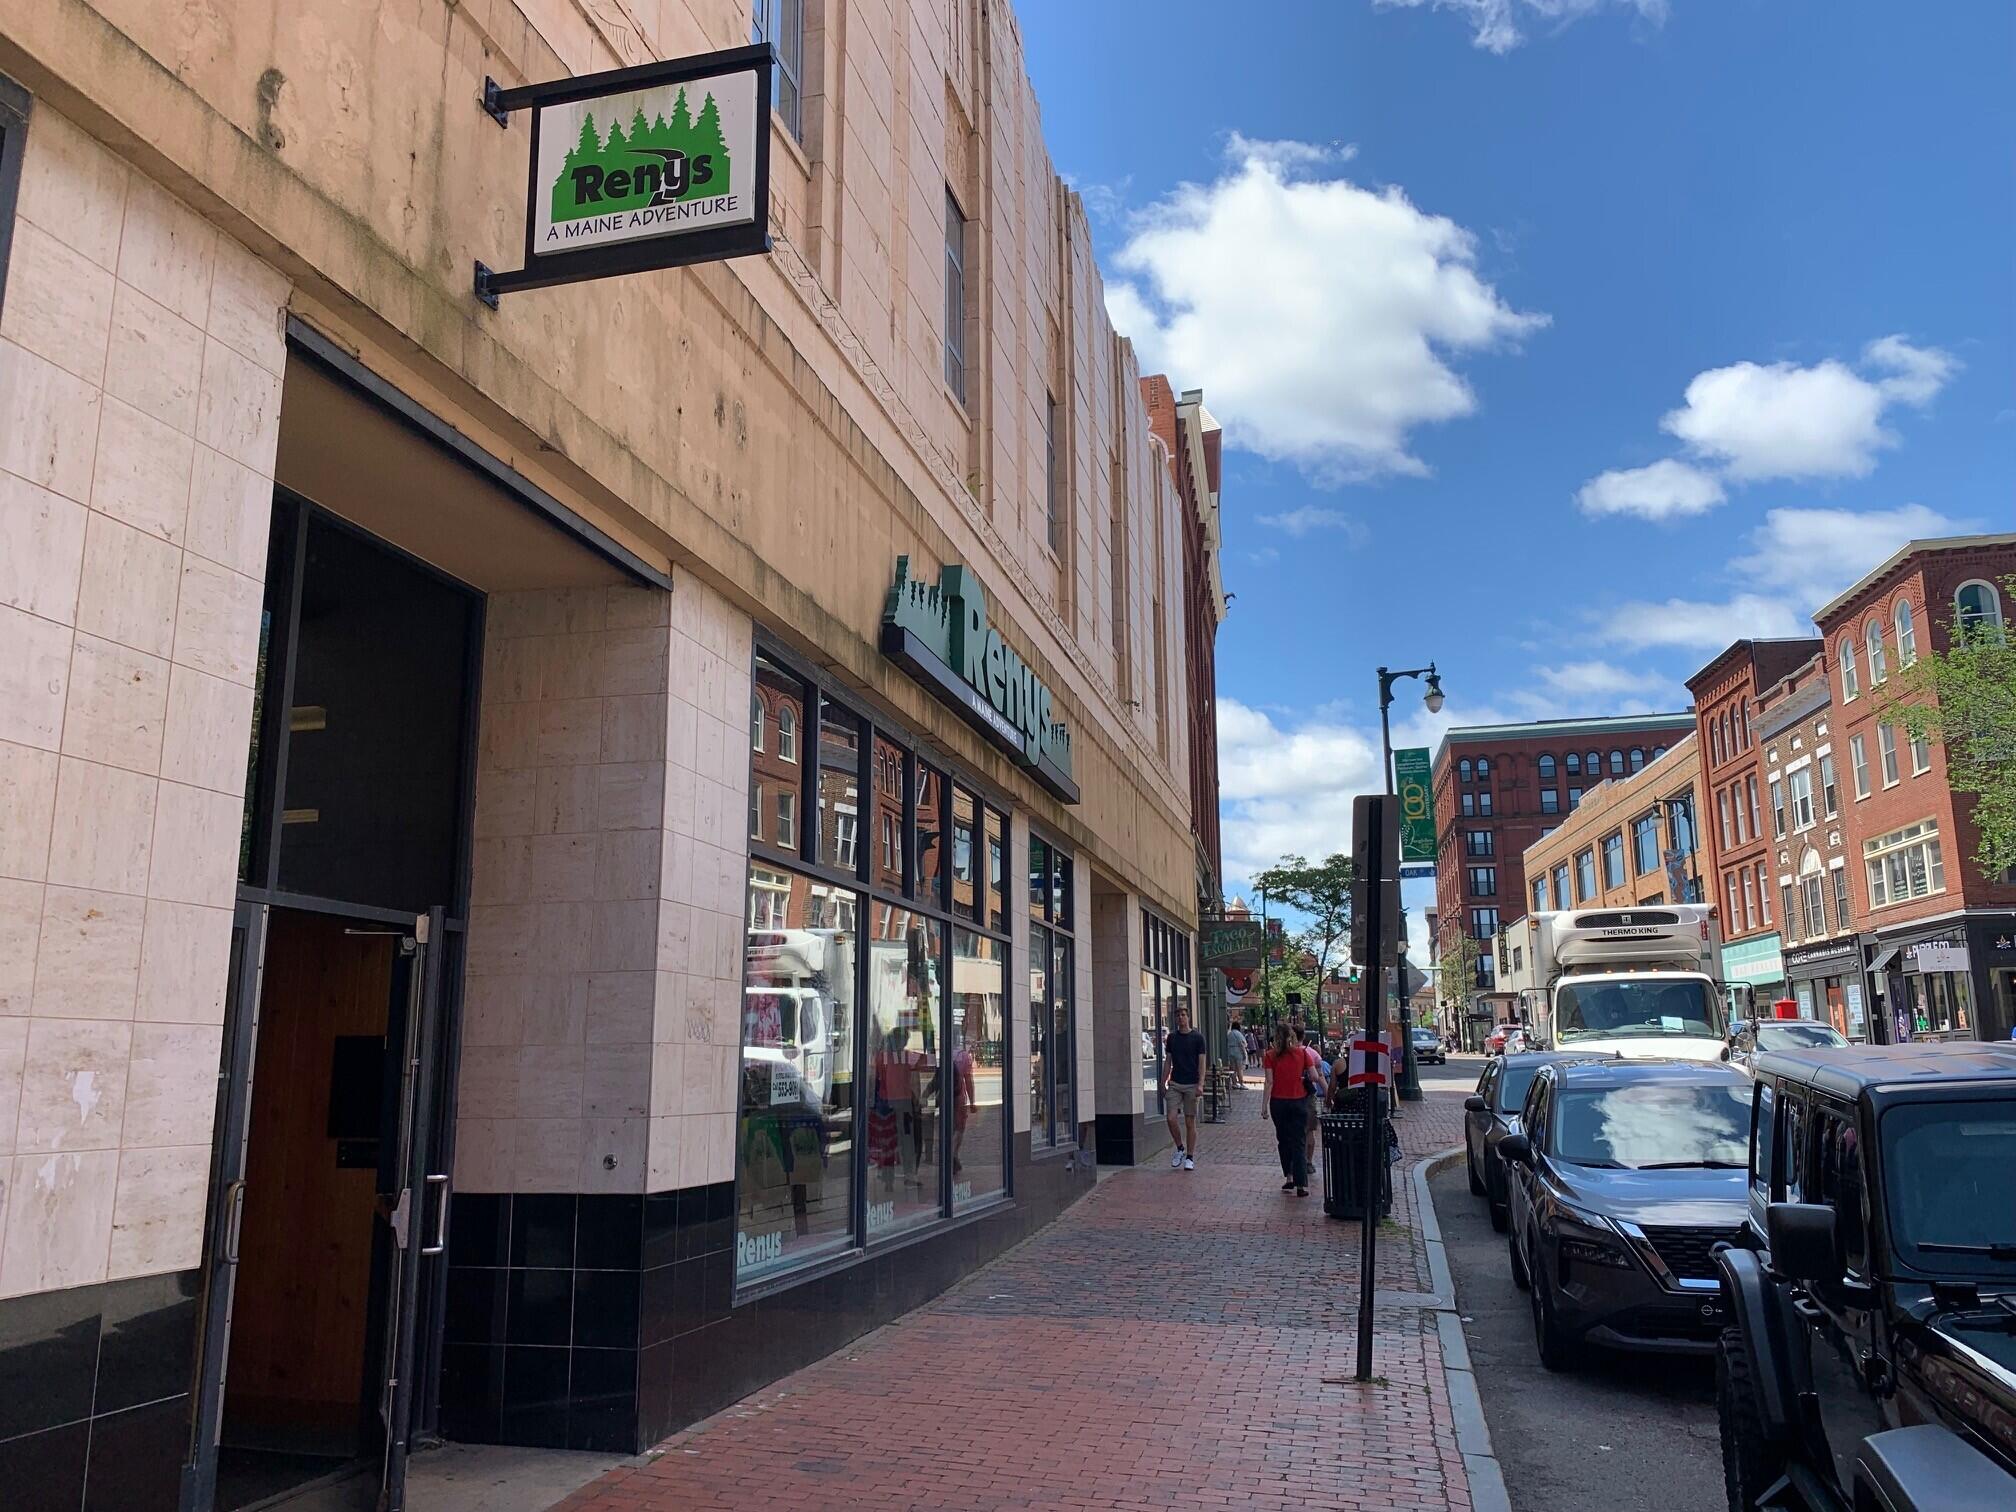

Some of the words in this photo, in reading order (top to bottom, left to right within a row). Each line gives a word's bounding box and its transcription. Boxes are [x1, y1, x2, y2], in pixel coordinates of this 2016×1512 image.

[571, 151, 713, 206] Renys
[546, 226, 559, 241] A
[565, 215, 623, 238] MAINE
[629, 195, 738, 228] ADVENTURE
[959, 564, 1053, 767] Renys
[976, 699, 992, 723] MAINE
[993, 713, 1017, 745] ADVENTURE
[1403, 784, 1426, 824] 100
[1498, 924, 1508, 973] EMPIRE
[1602, 928, 1637, 936] THERMO
[737, 1231, 782, 1267] Renys
